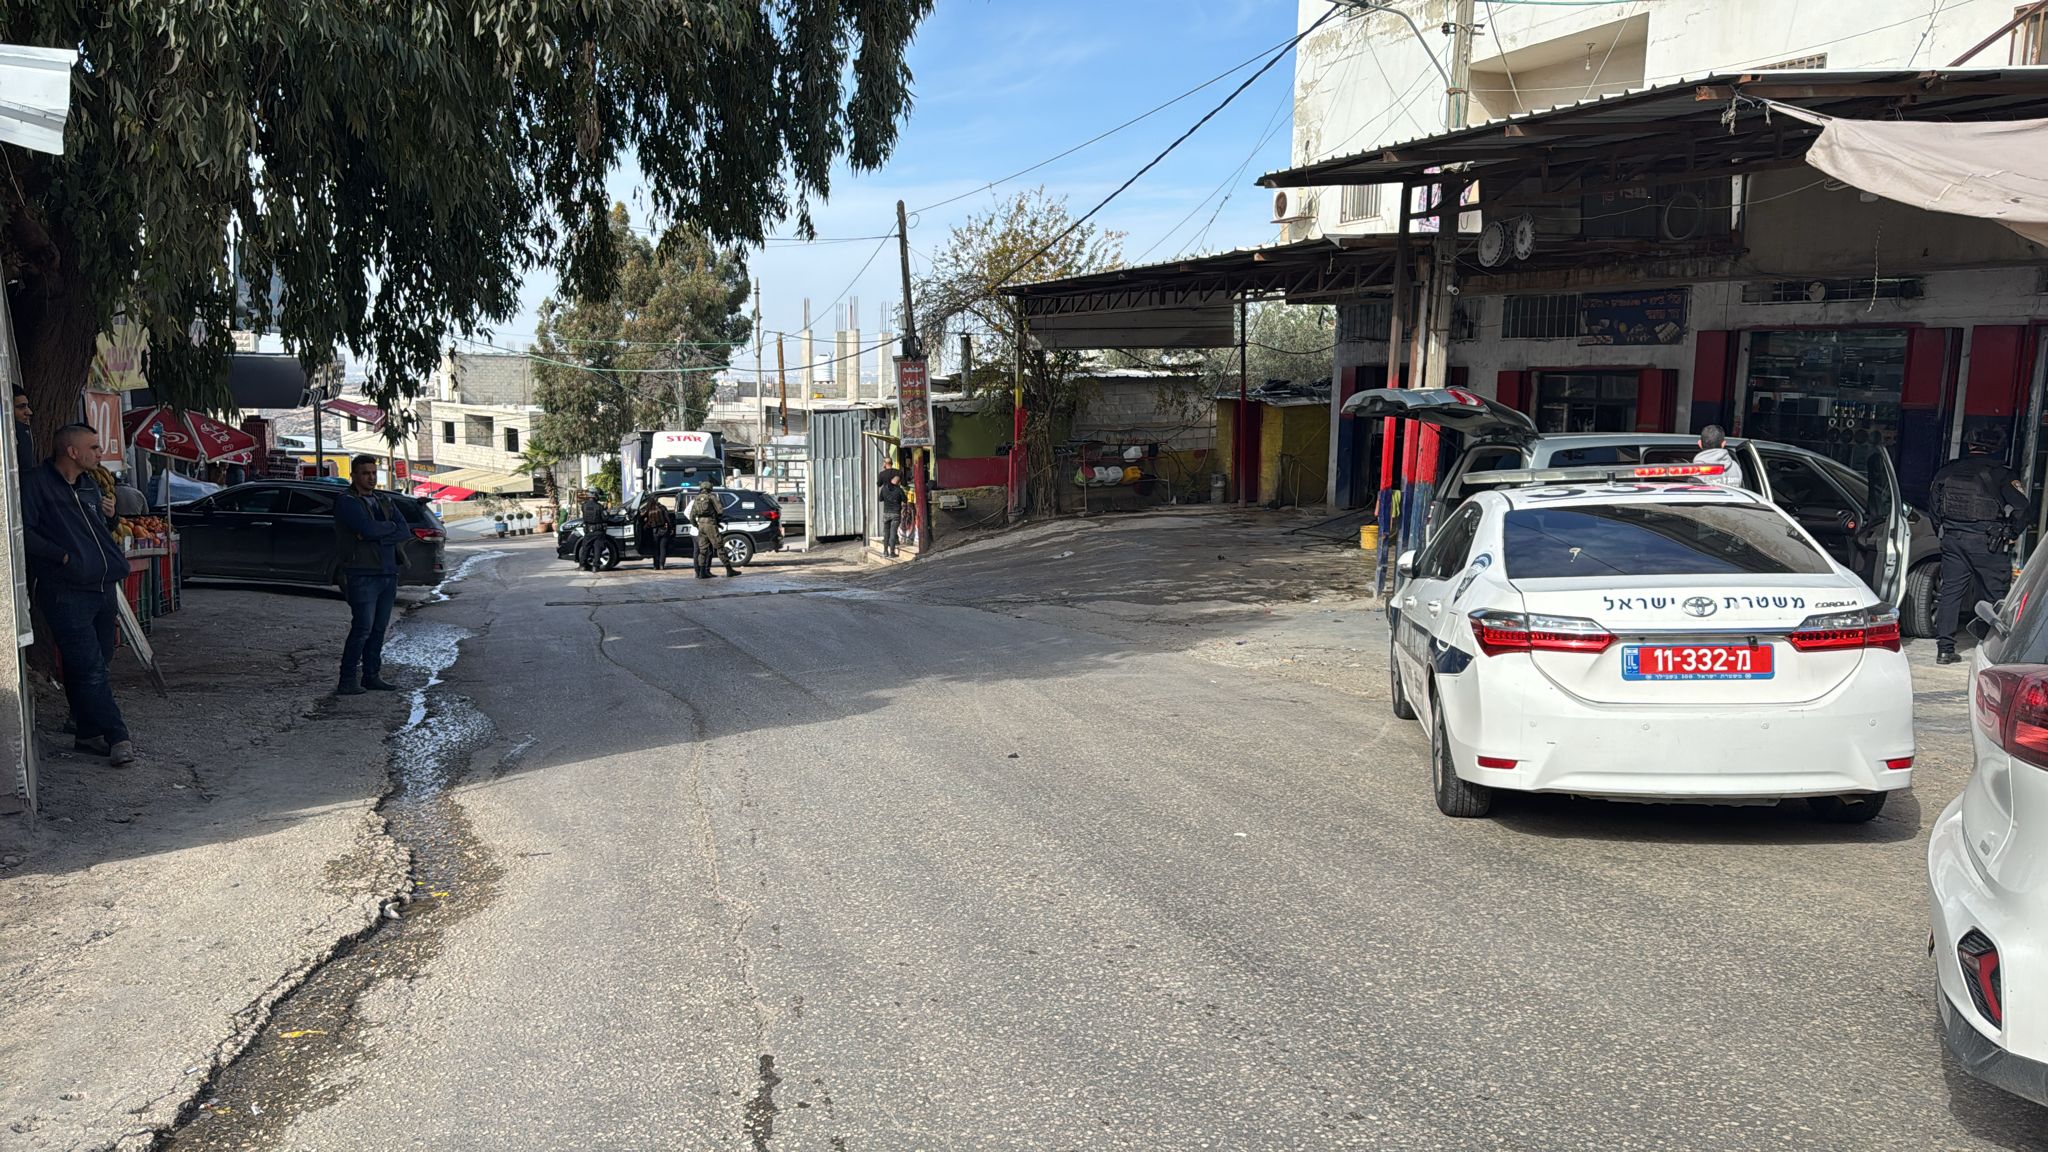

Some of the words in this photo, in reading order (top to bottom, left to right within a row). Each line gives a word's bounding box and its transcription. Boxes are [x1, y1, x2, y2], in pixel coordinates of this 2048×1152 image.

[1603, 596, 1675, 610] ישראל
[1723, 596, 1805, 609] משטרת
[1815, 600, 1858, 608] COROLLA
